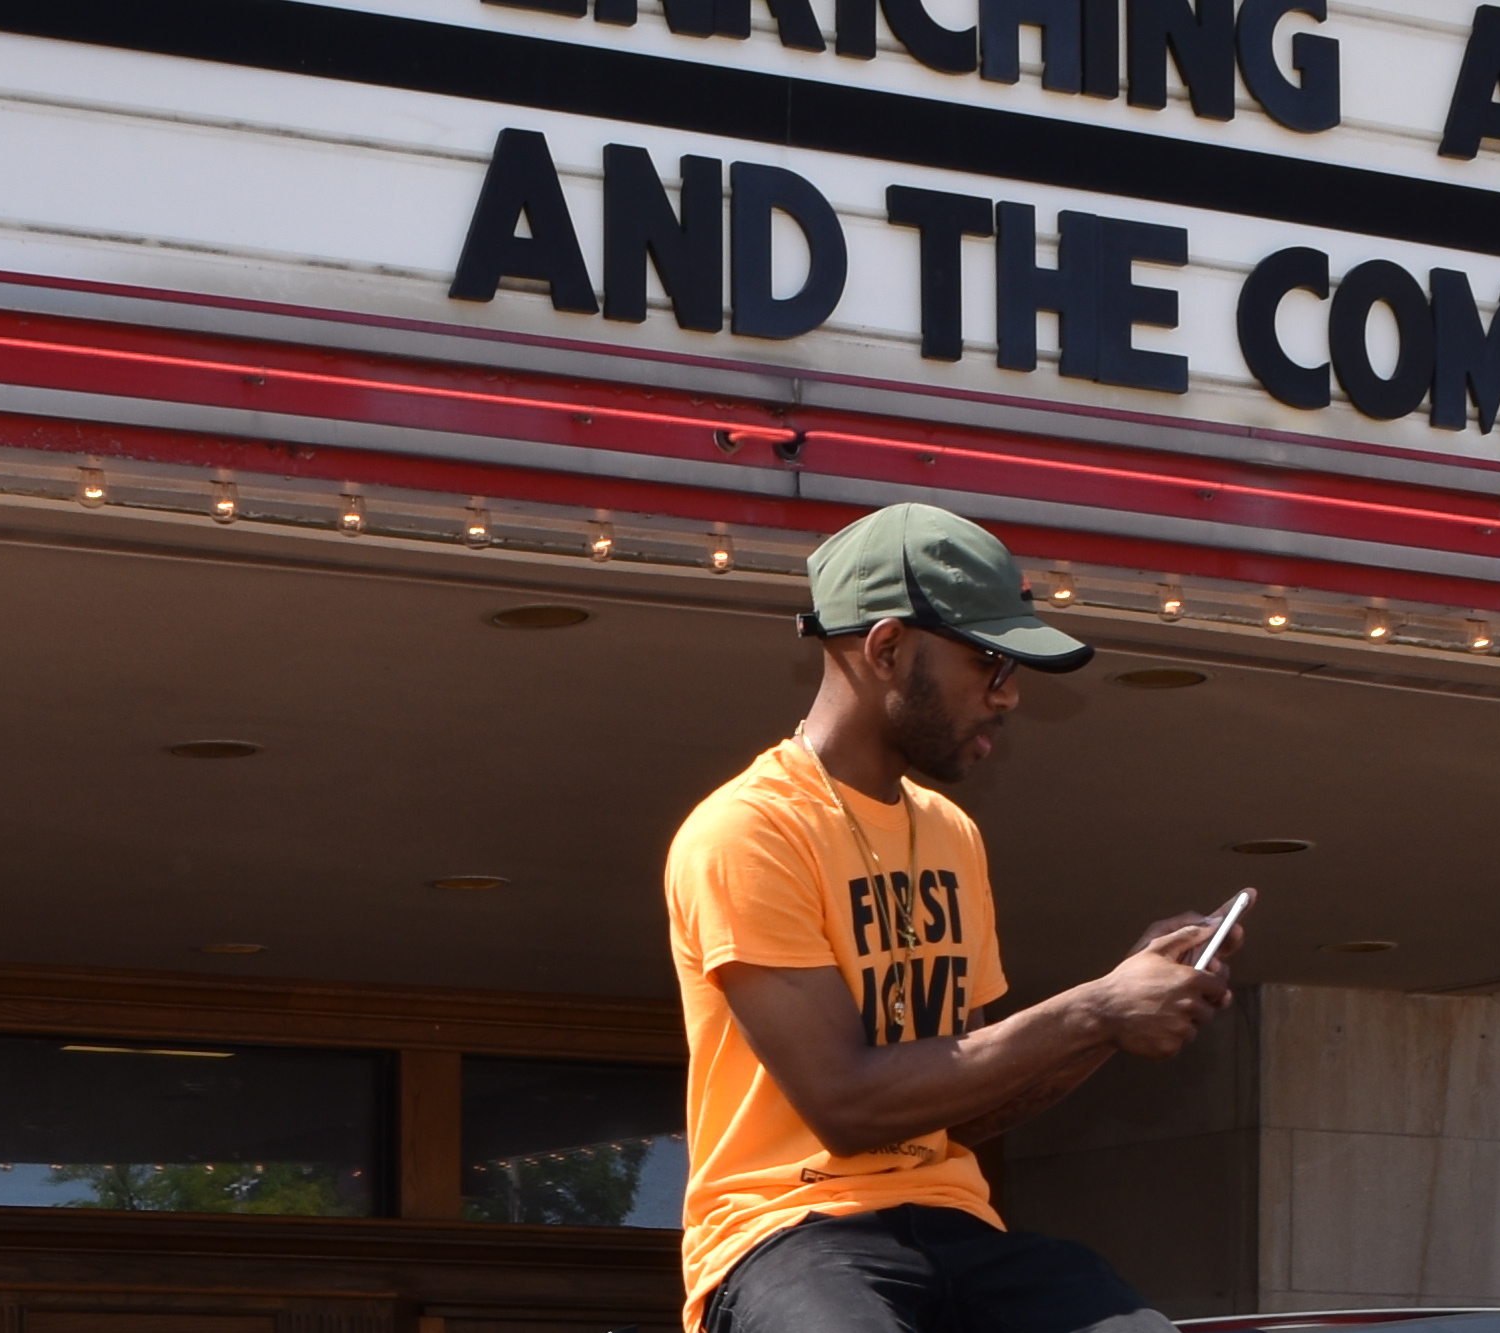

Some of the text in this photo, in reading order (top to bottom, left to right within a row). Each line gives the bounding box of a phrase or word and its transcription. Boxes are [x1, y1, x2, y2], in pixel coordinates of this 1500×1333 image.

[480, 0, 1342, 134] CHING
[450, 127, 848, 341] AND
[885, 183, 1190, 393] THE
[848, 867, 963, 957] FIRST
[861, 955, 968, 1048] LOVE
